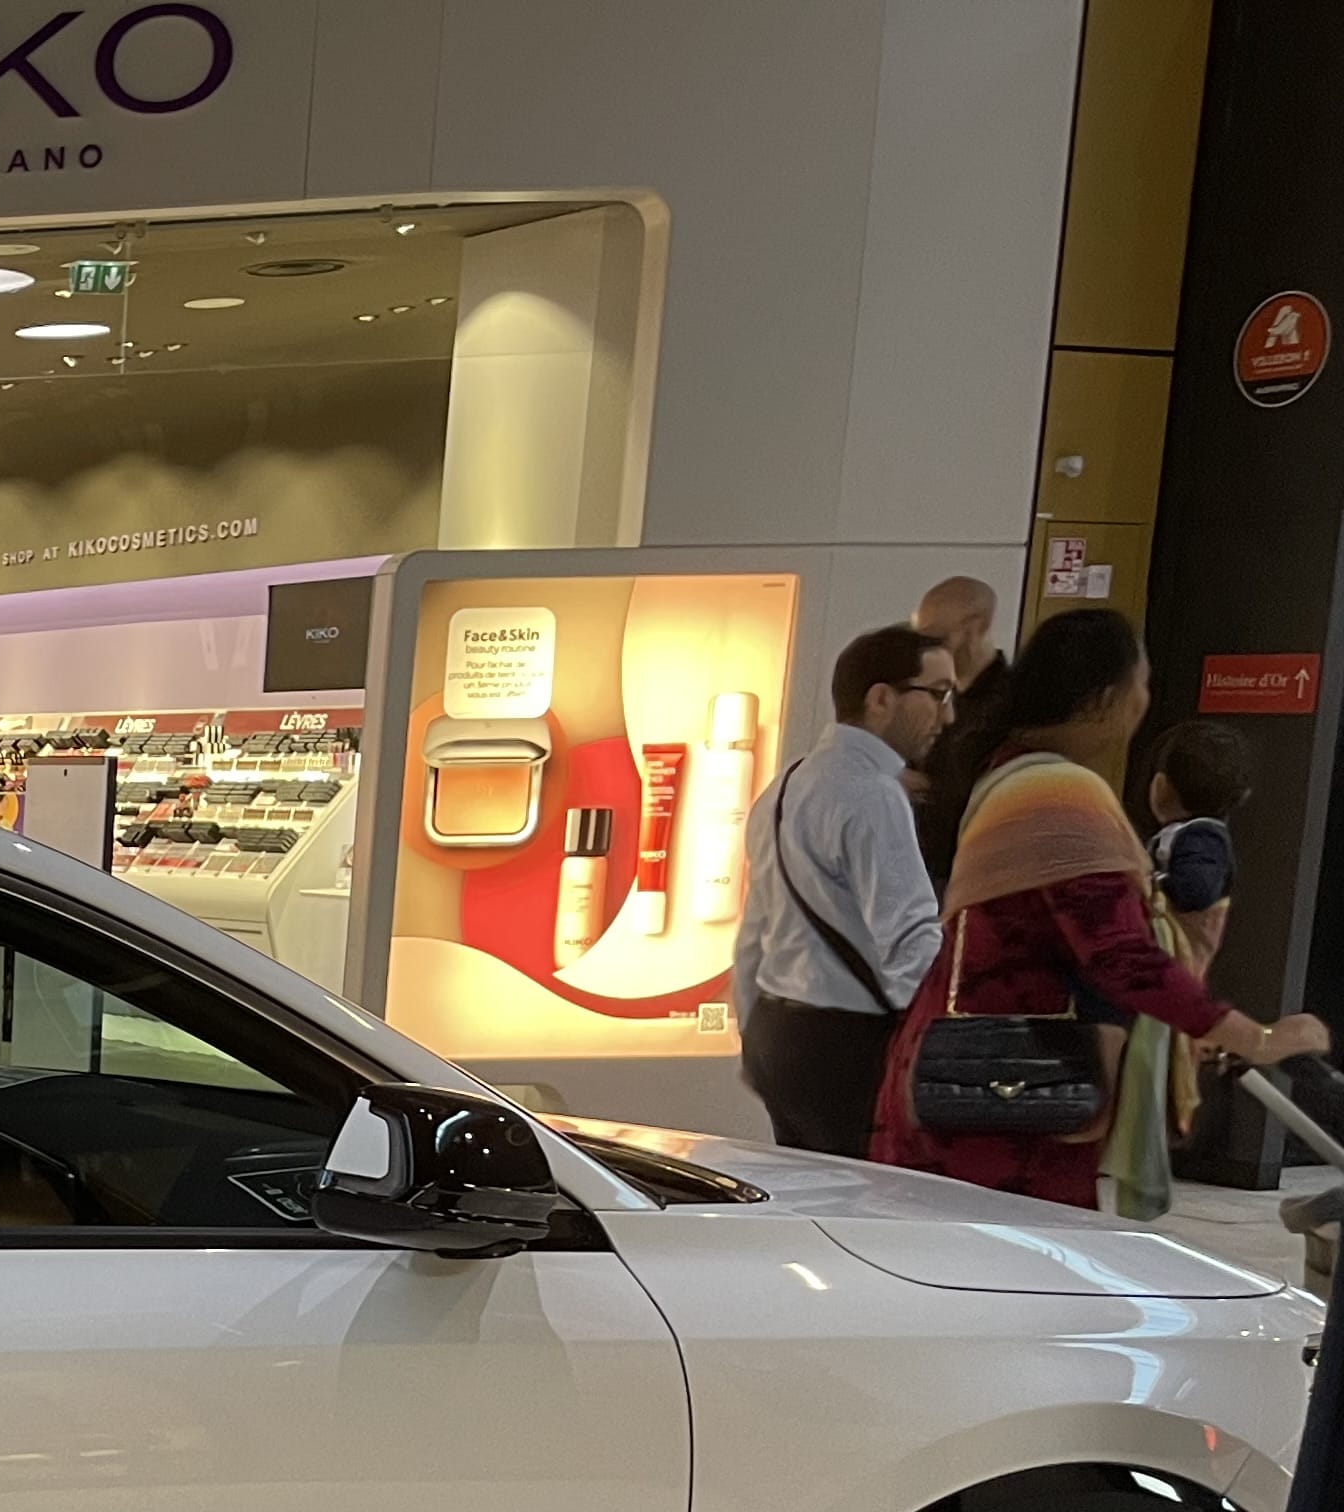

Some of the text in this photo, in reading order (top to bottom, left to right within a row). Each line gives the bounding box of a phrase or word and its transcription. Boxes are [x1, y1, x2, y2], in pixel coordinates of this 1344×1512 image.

[2, 518, 258, 566] SHOP AT KIKOCOSMETICS.COM
[464, 627, 540, 643] Face&Skin
[279, 711, 328, 731] LÈVRES
